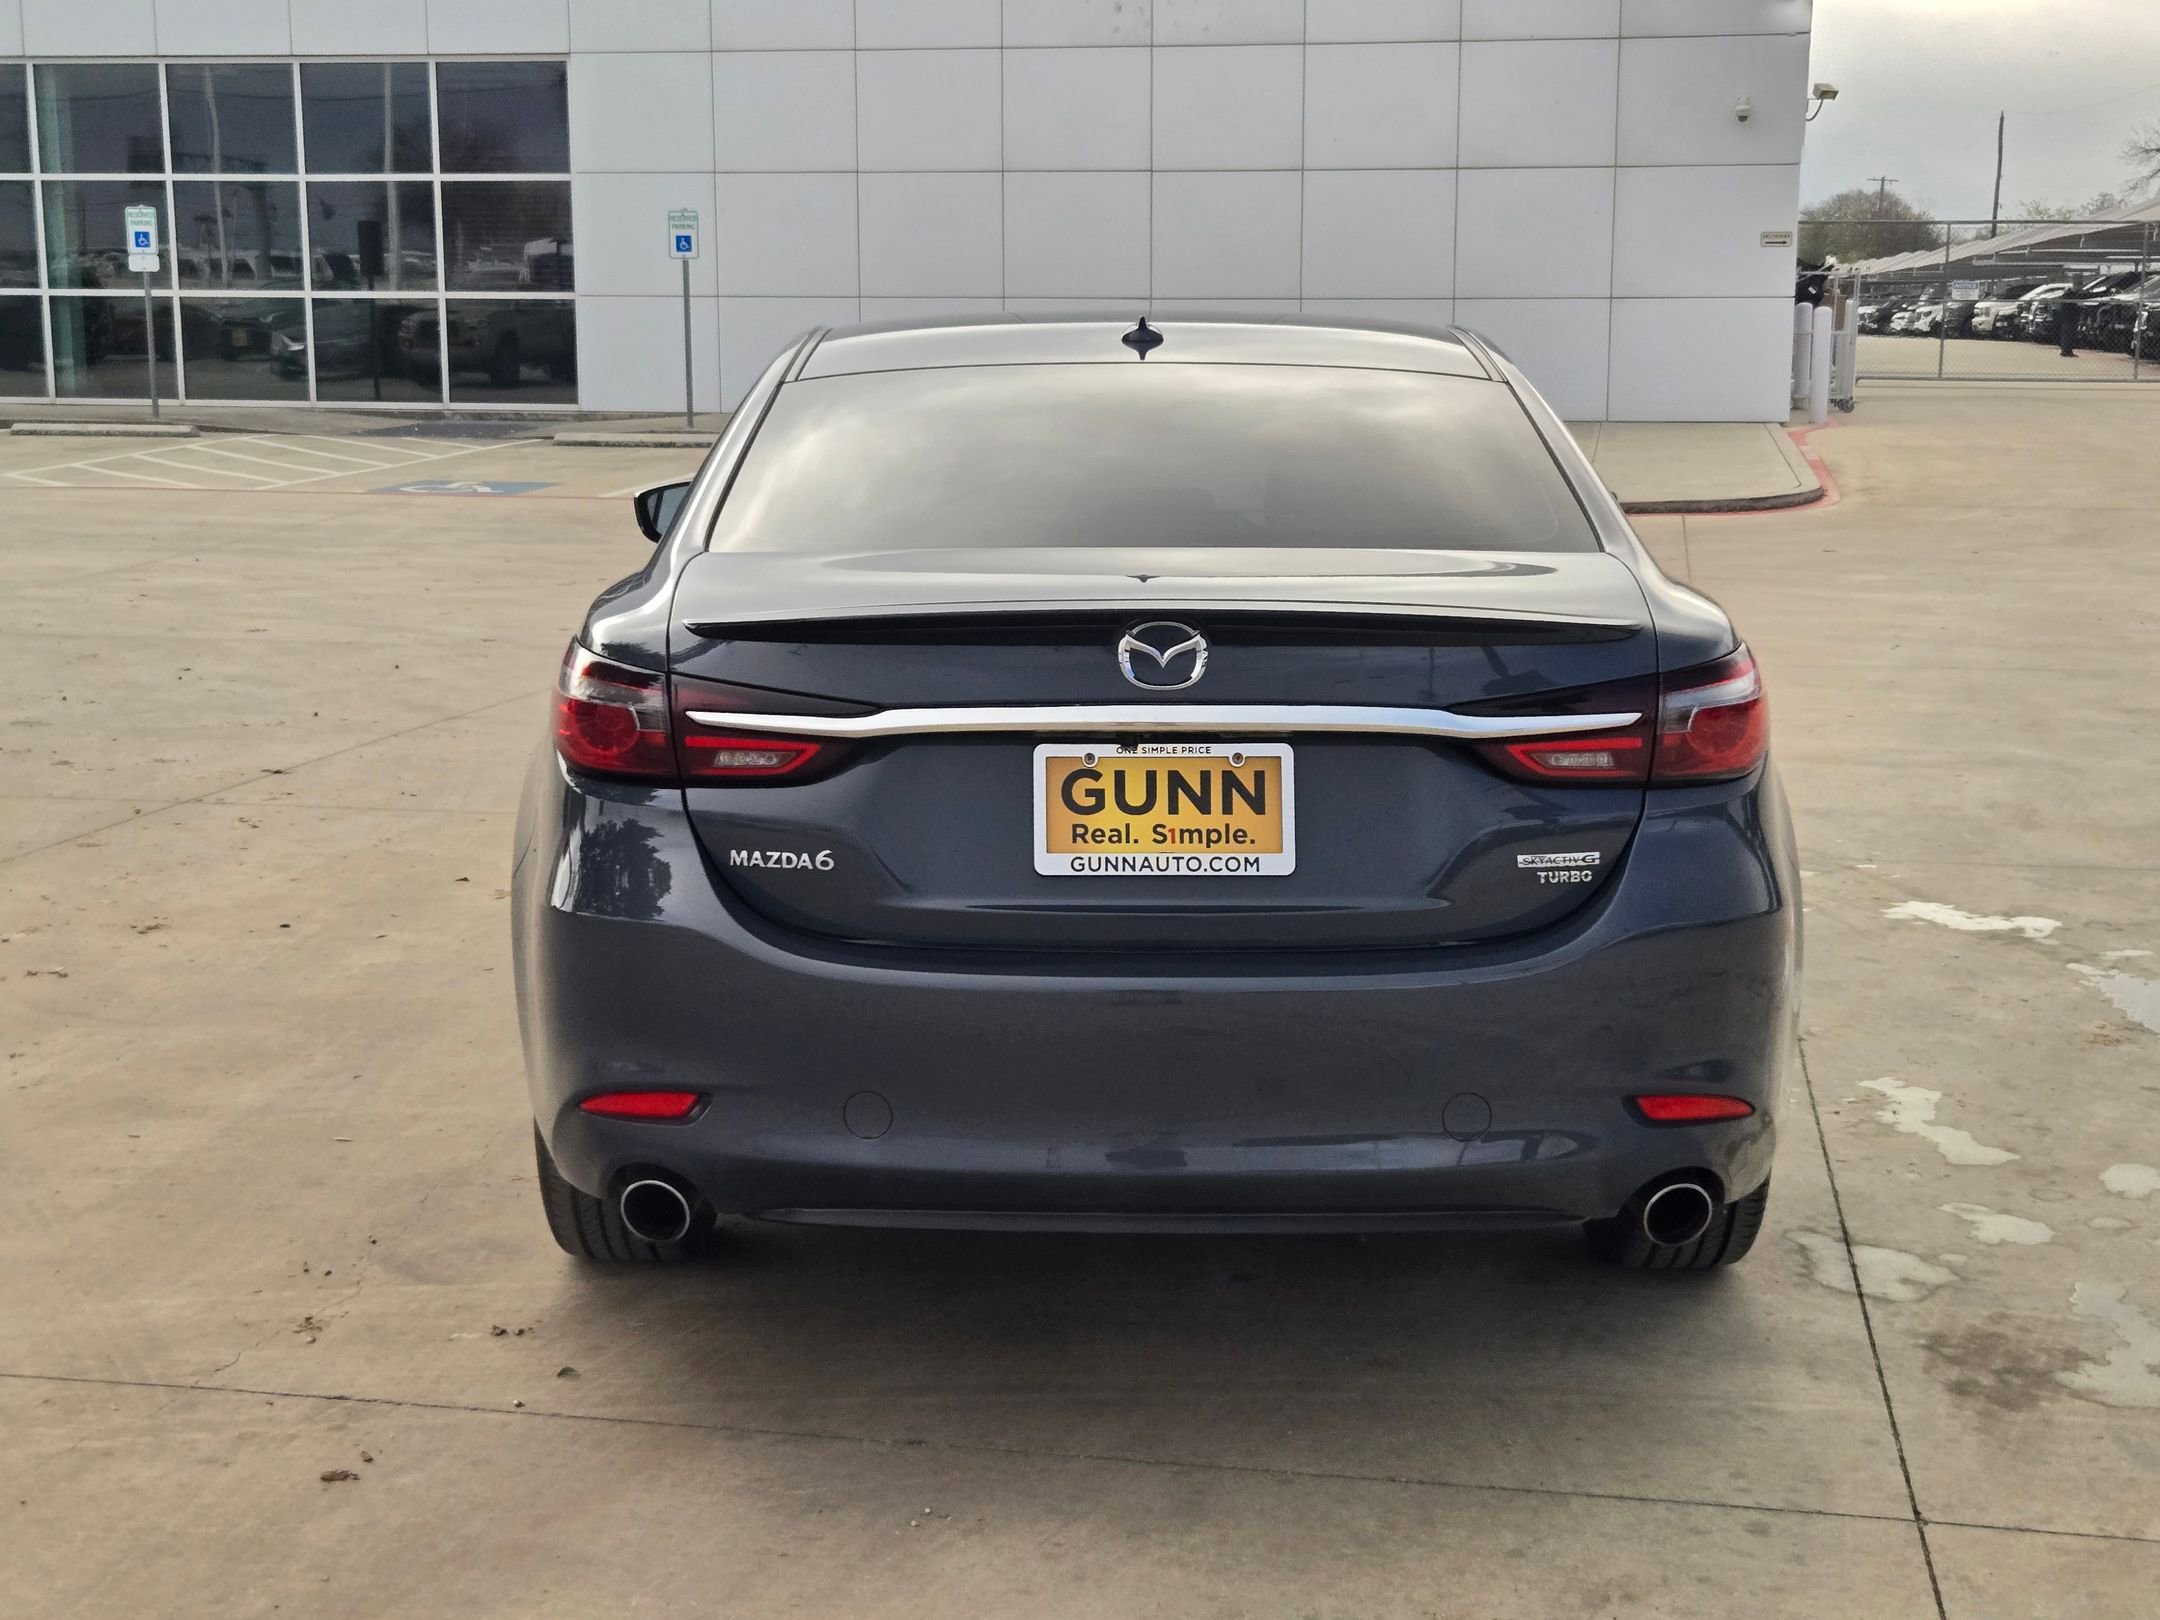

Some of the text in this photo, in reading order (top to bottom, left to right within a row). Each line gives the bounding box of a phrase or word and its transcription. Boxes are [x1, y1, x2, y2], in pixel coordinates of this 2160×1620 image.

[1141, 746, 1178, 754] SIMPLE
[1181, 746, 1211, 754] PRICE
[1061, 768, 1266, 816] GUNN
[1071, 822, 1256, 849] Real. S1mple.
[729, 849, 835, 871] MAZDA6
[1070, 856, 1260, 873] GUNNAUTO.COM
[1537, 870, 1593, 884] TURBO
